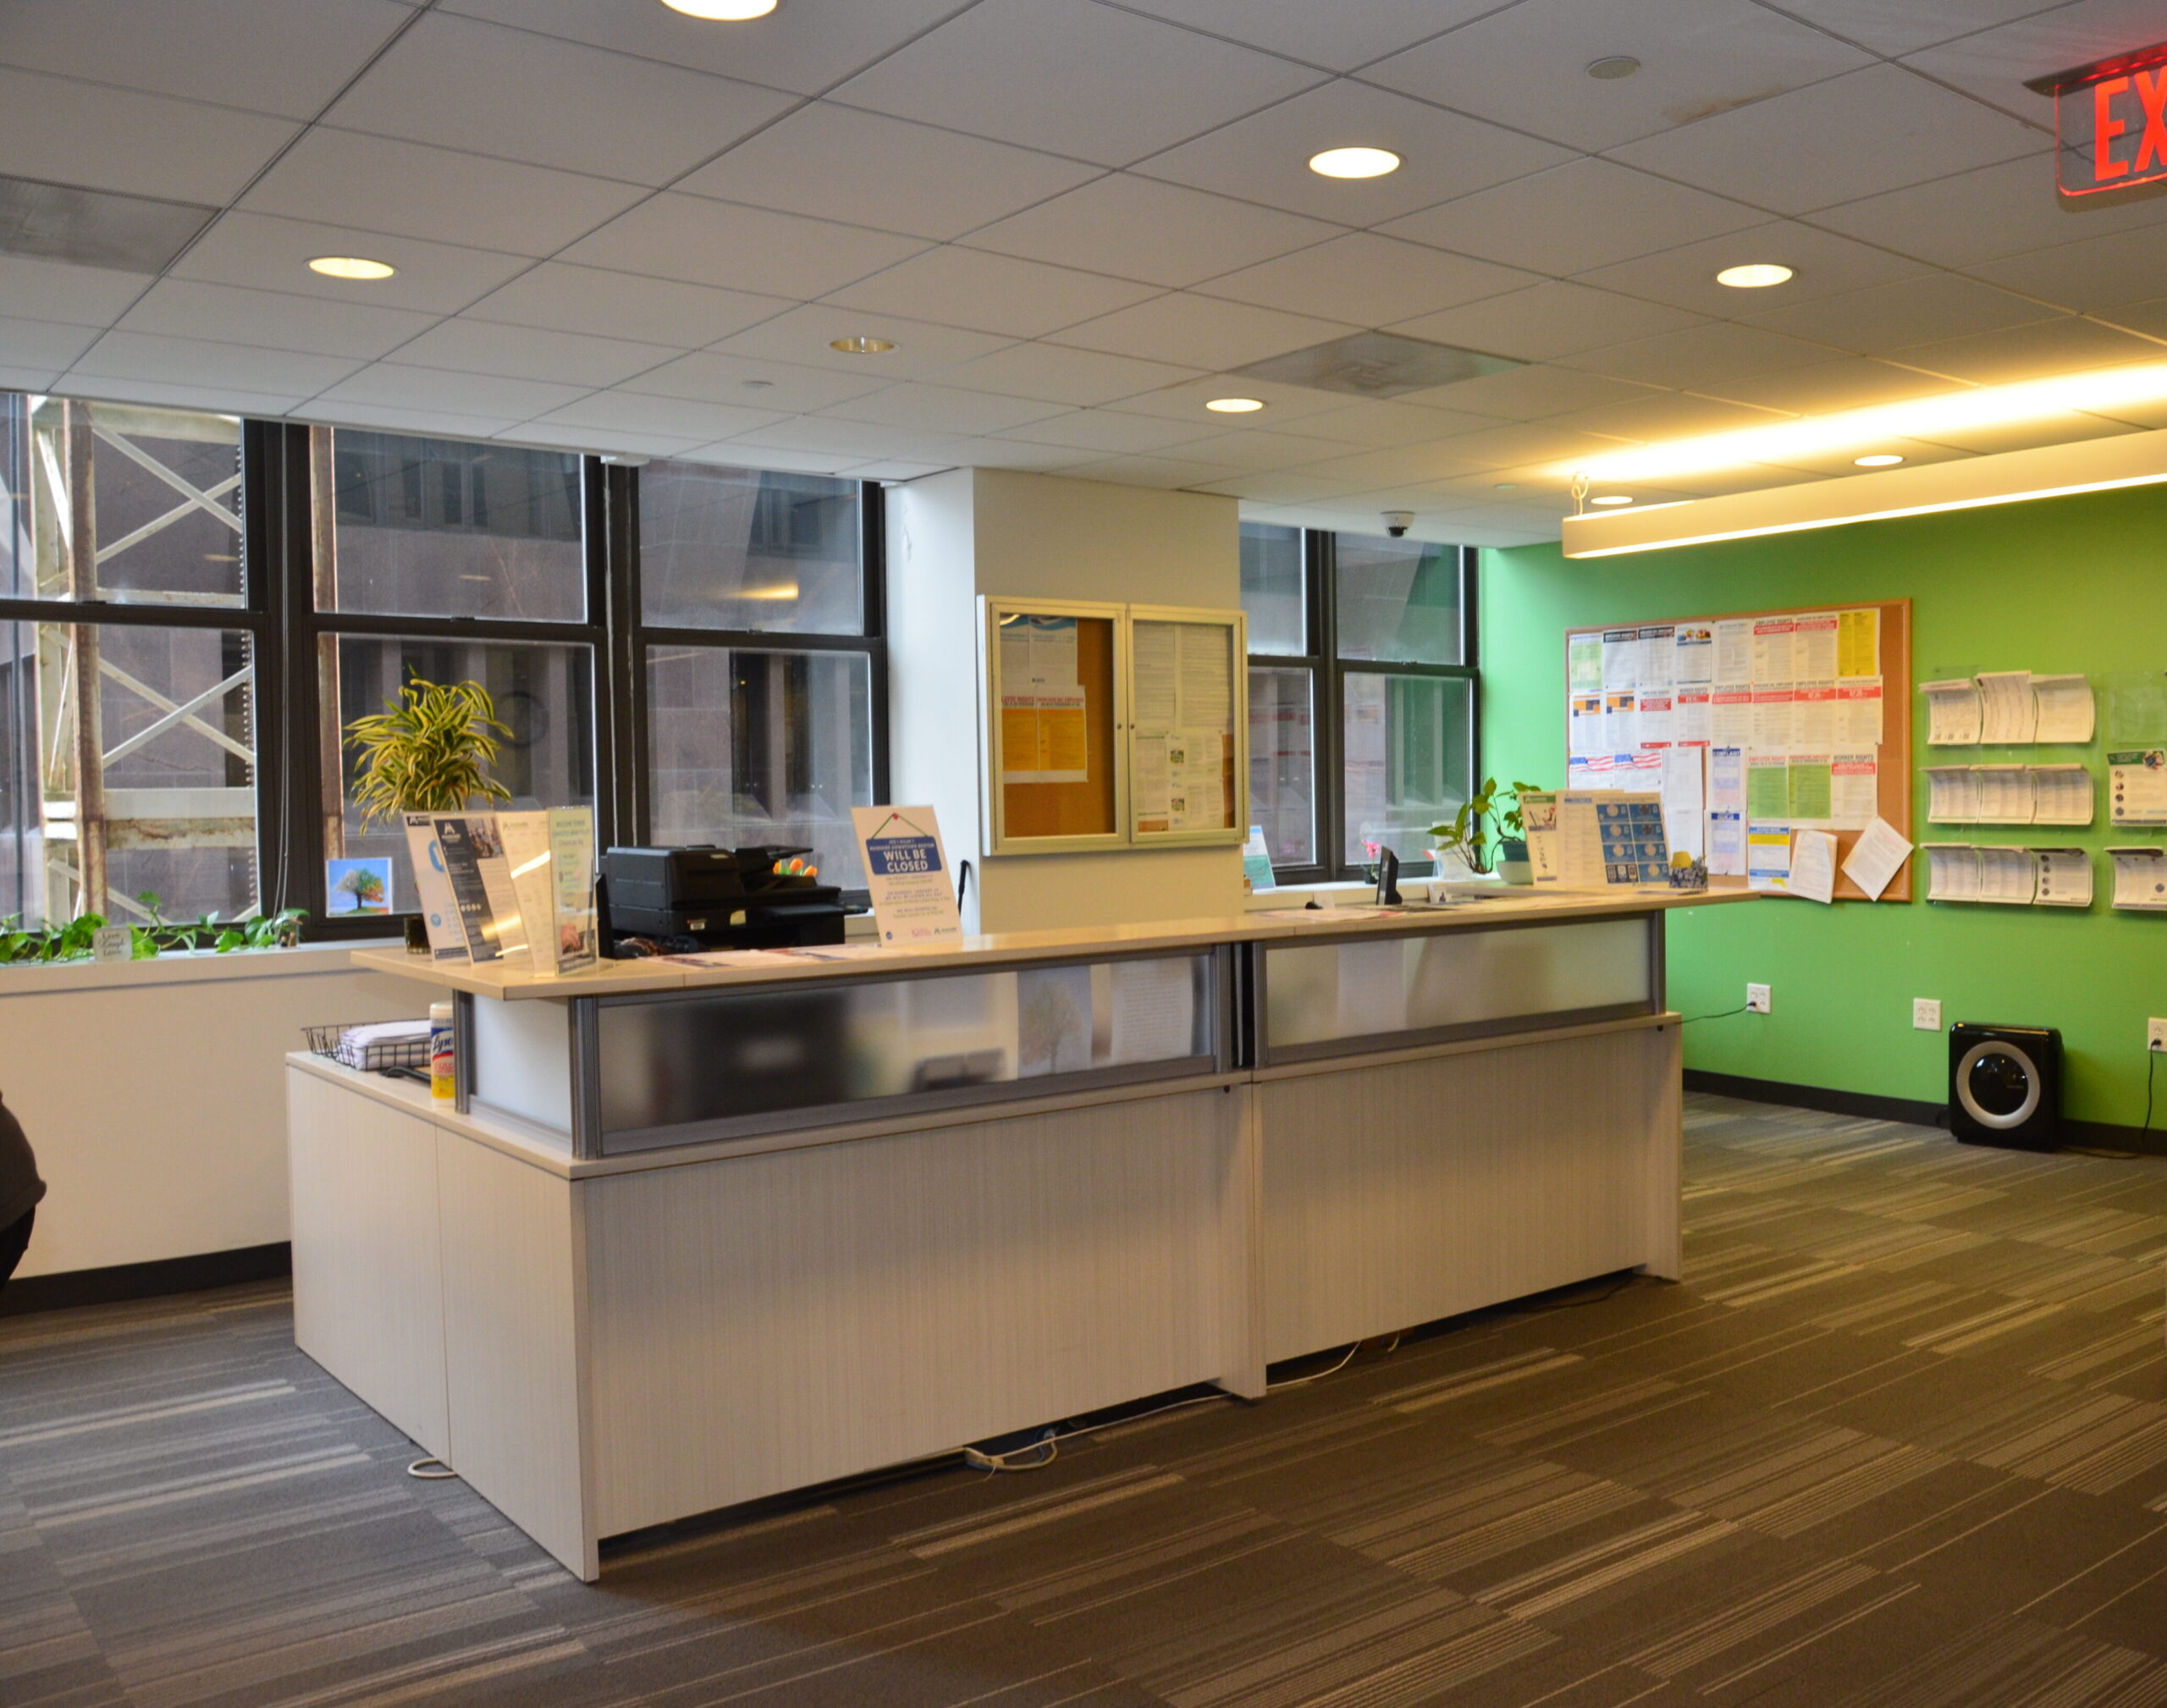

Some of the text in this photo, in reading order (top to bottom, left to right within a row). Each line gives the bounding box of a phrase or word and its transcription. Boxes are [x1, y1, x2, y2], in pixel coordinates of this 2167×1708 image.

[2095, 64, 2167, 181] EX
[884, 848, 927, 862] WILL BE
[886, 860, 929, 873] CLOSED
